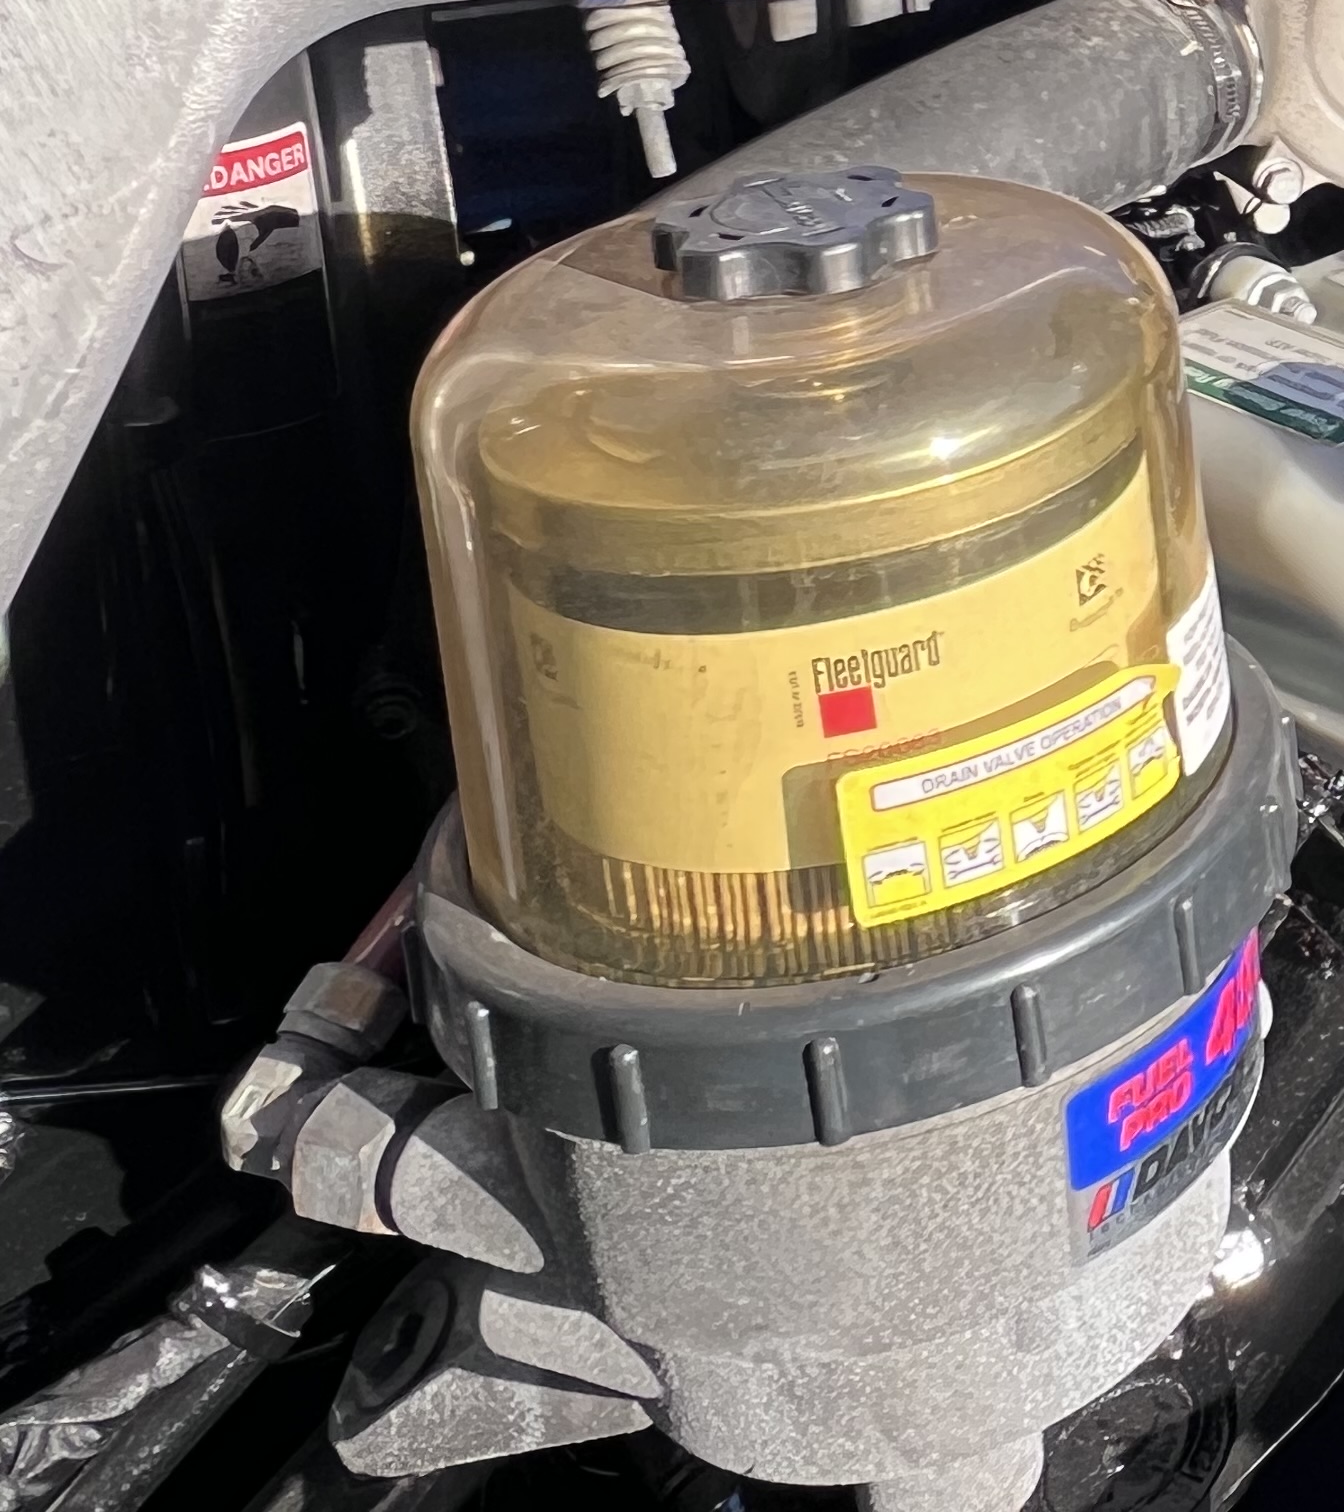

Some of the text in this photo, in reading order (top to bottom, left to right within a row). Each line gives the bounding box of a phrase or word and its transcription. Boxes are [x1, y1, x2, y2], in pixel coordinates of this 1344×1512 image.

[210, 143, 305, 189] DANGER
[811, 630, 942, 695] Fleetguard
[921, 764, 979, 794] DRAIN
[983, 741, 1036, 773] VALVE
[1040, 697, 1122, 750] OPERATION
[1108, 1037, 1194, 1124] FUEL
[1120, 1070, 1193, 1152] PRO
